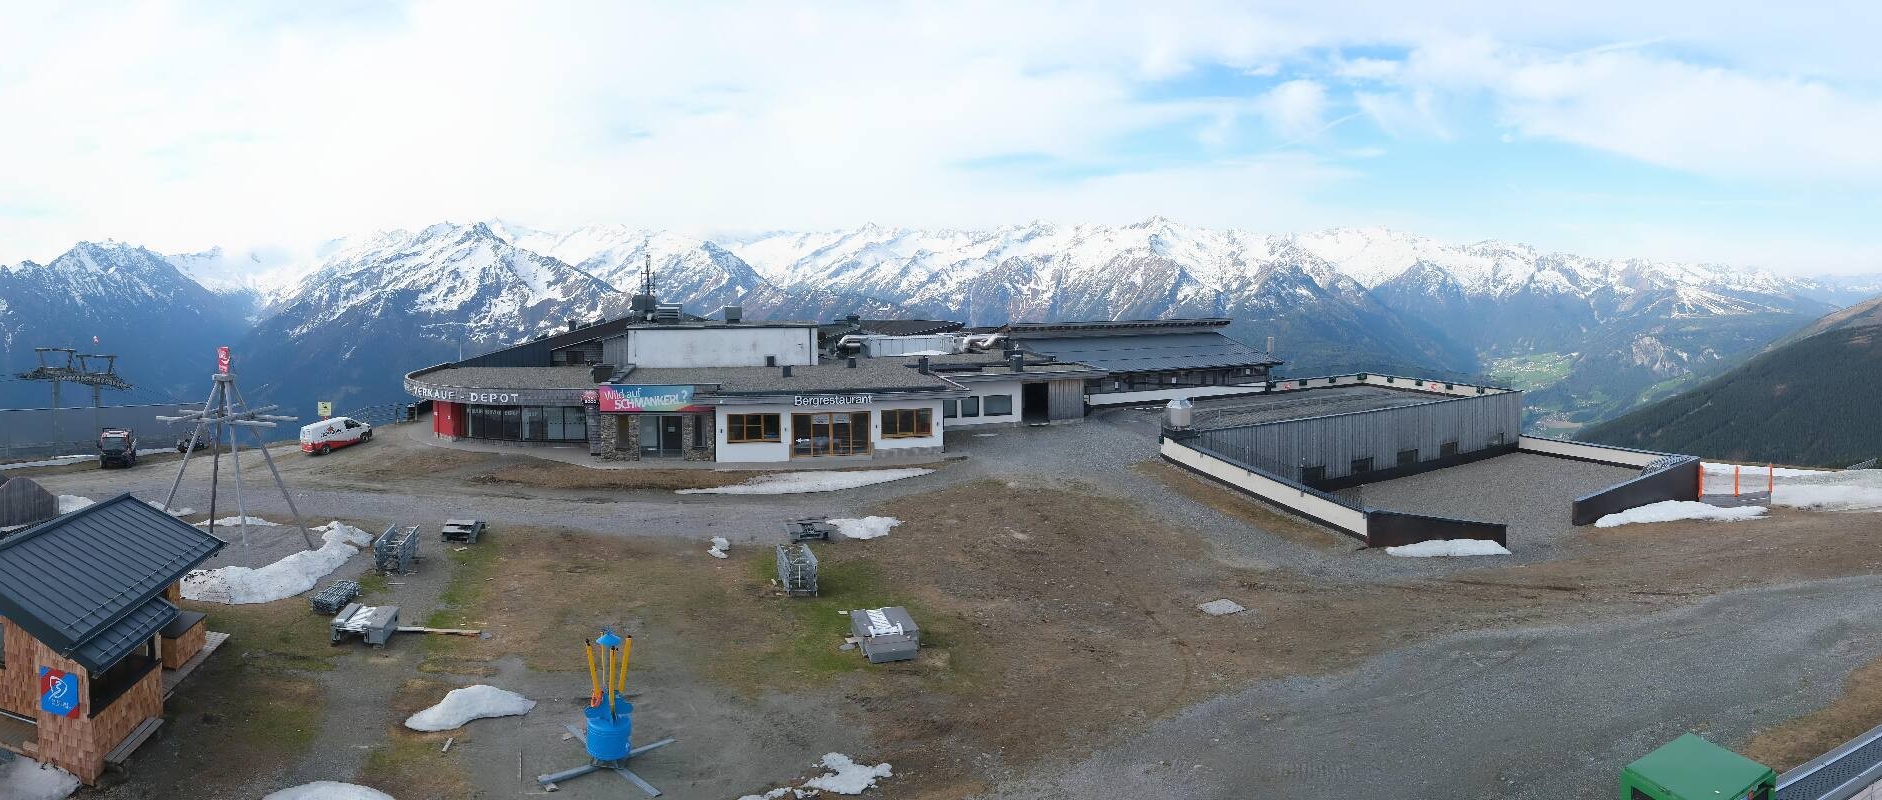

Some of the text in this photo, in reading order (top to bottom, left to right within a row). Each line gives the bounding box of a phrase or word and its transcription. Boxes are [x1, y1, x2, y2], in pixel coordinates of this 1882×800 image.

[414, 385, 455, 400] VERKAUF
[470, 392, 519, 403] DEPOT
[604, 388, 642, 400] Wild auf
[795, 394, 873, 407] Bergrestaurant
